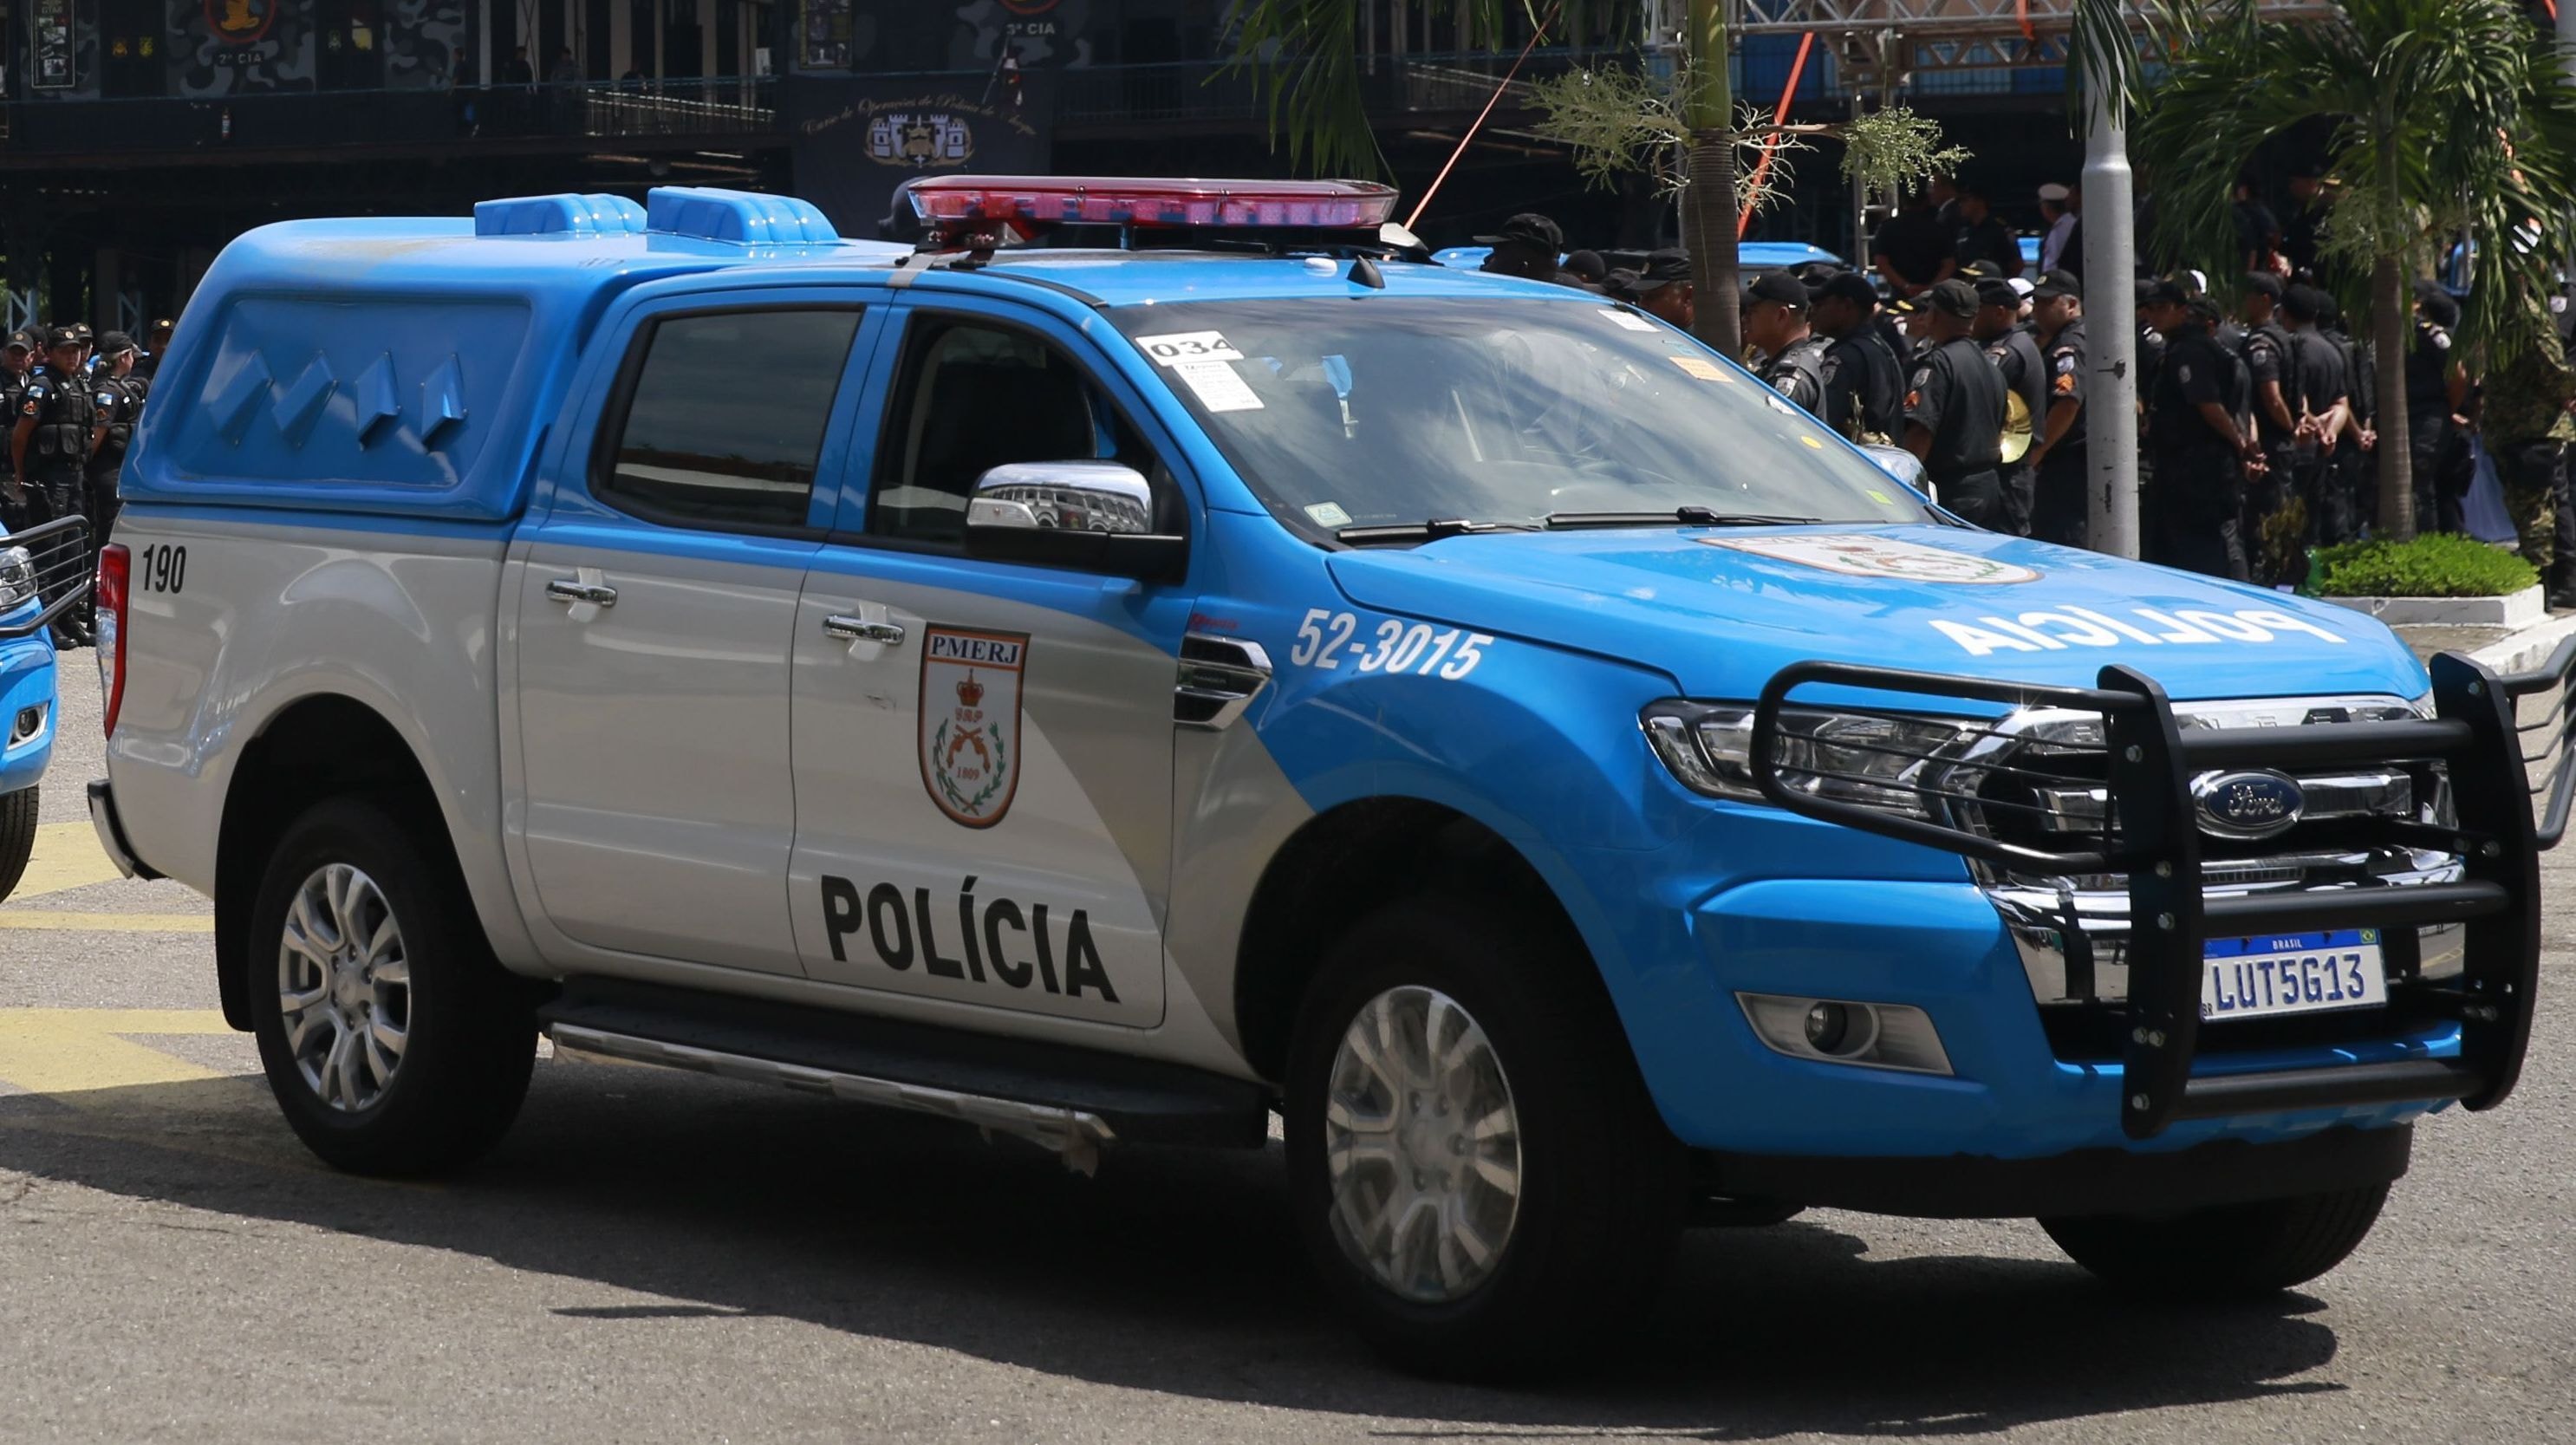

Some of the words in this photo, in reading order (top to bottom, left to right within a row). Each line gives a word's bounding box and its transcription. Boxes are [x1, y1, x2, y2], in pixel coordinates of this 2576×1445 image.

[1026, 22, 1055, 36] CIA
[237, 52, 262, 65] CIA
[142, 543, 187, 594] 190
[930, 635, 1020, 665] PMERJ
[1291, 607, 1495, 680] 52-3015
[956, 766, 980, 782] 1809
[2228, 783, 2285, 817] Ford
[820, 875, 1121, 1005] POLÍCIA
[2272, 938, 2303, 951] BRASIL
[2212, 954, 2365, 1011] LUT5G13
